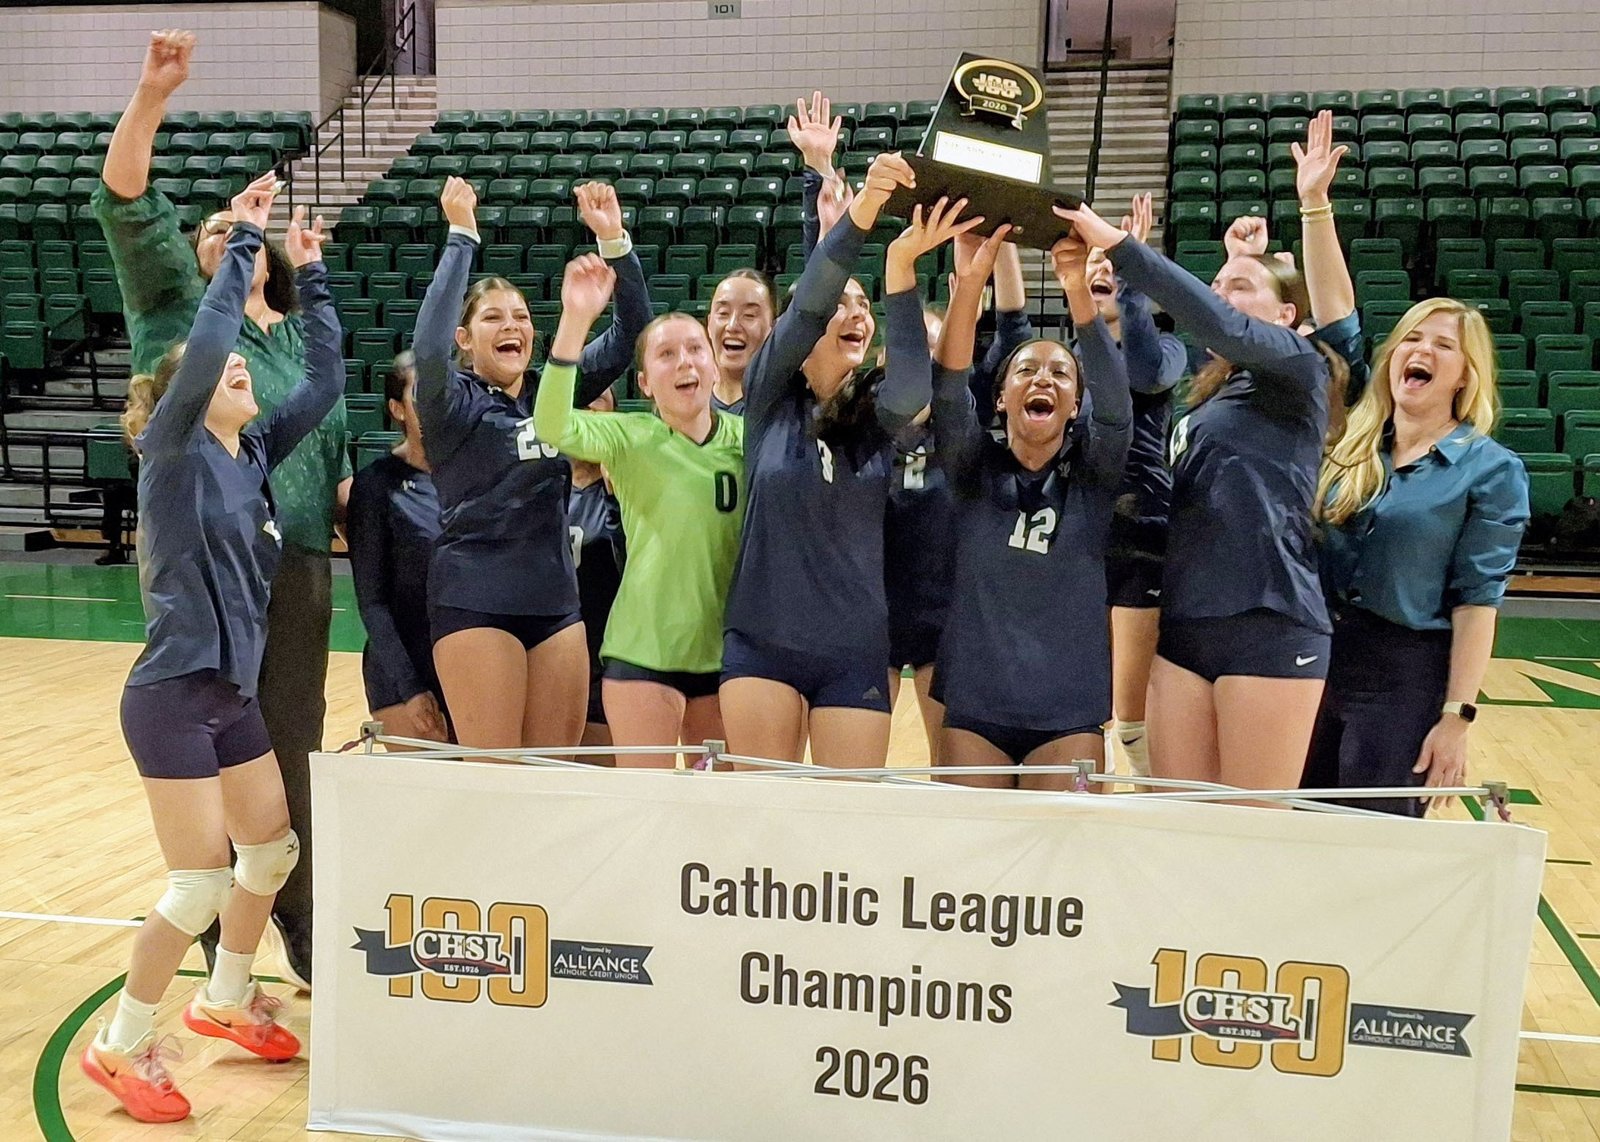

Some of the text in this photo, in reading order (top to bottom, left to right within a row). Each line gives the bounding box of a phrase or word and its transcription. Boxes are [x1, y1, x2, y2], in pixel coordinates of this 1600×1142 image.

[714, 4, 734, 13] 101
[982, 99, 1007, 111] 2026
[715, 470, 737, 512] 0
[1008, 507, 1056, 554] 12
[680, 862, 1084, 947] Catholic League
[384, 893, 549, 1008] 100
[416, 932, 508, 968] CHSL
[443, 964, 480, 973] EST.1926
[554, 953, 639, 973] ALLIANCE
[554, 968, 639, 980] CATHOLIC CREDIT UNION
[740, 952, 1013, 1027] Champions
[1151, 948, 1350, 1077] 100
[1186, 991, 1297, 1031] CHSL
[1353, 1018, 1457, 1043] ALLIANCE
[814, 1046, 929, 1105] 2026
